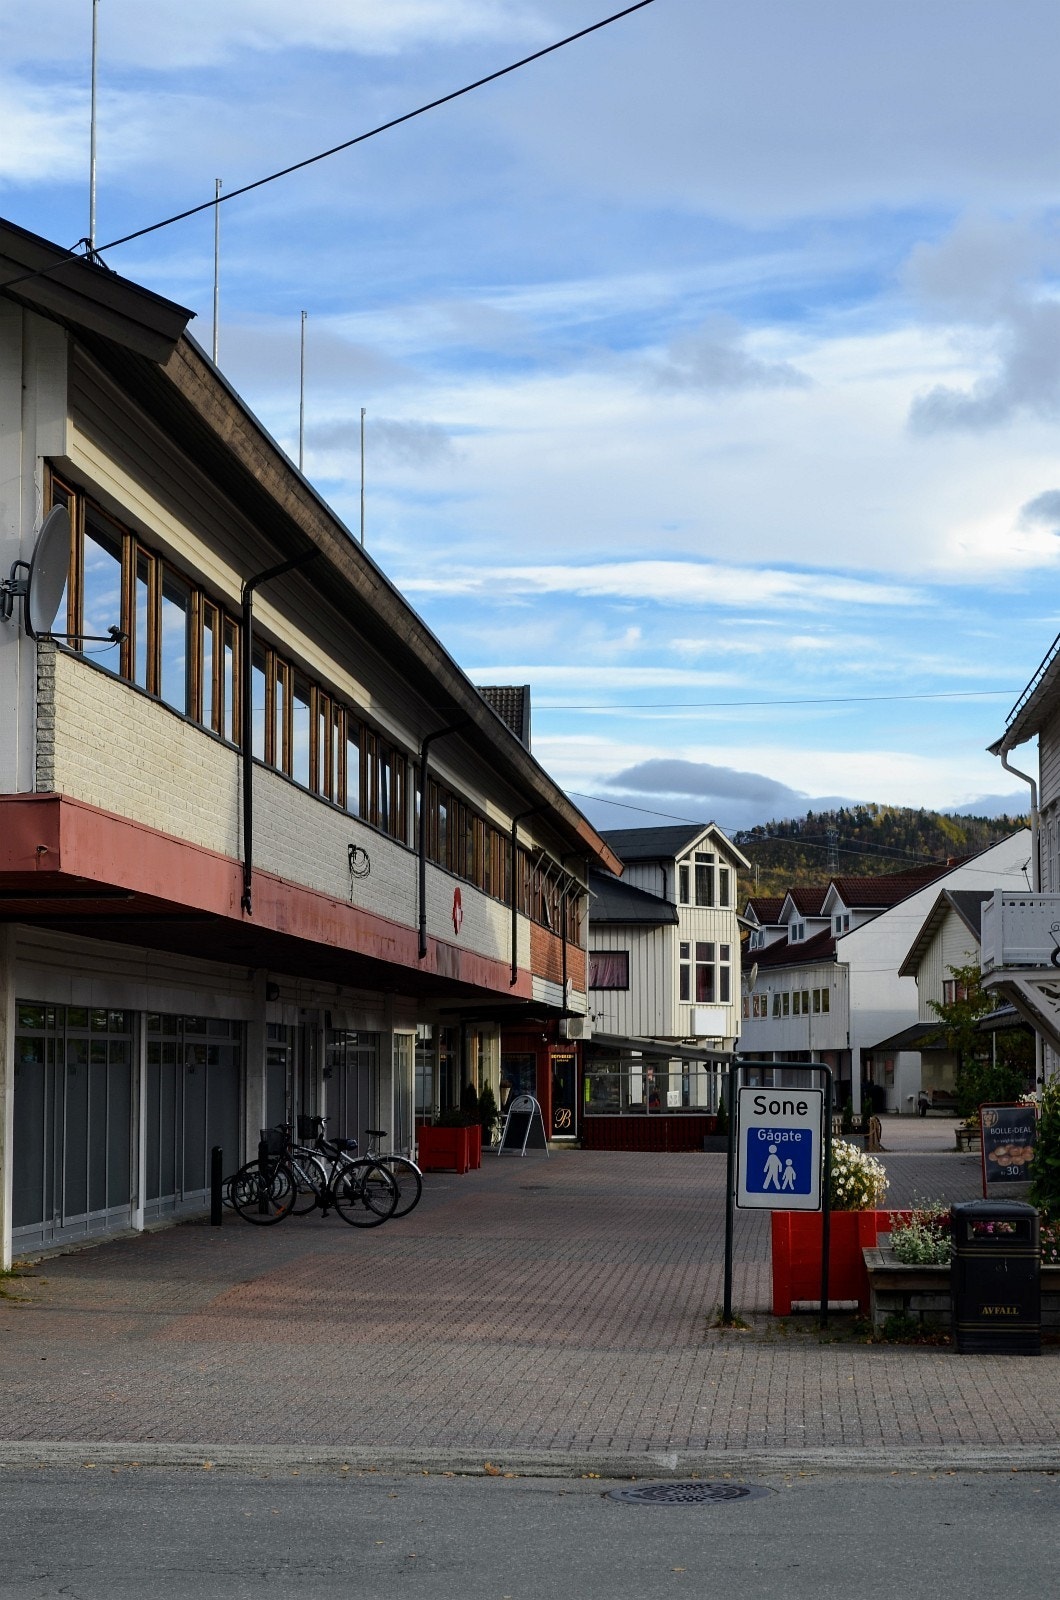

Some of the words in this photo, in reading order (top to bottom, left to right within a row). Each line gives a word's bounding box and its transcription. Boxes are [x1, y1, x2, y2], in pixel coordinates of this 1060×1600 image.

[753, 1096, 808, 1116] Sone
[990, 1126, 1032, 1134] BOLLE-DEAL
[757, 1129, 802, 1144] Gågate
[982, 1306, 1019, 1315] AVFALL
